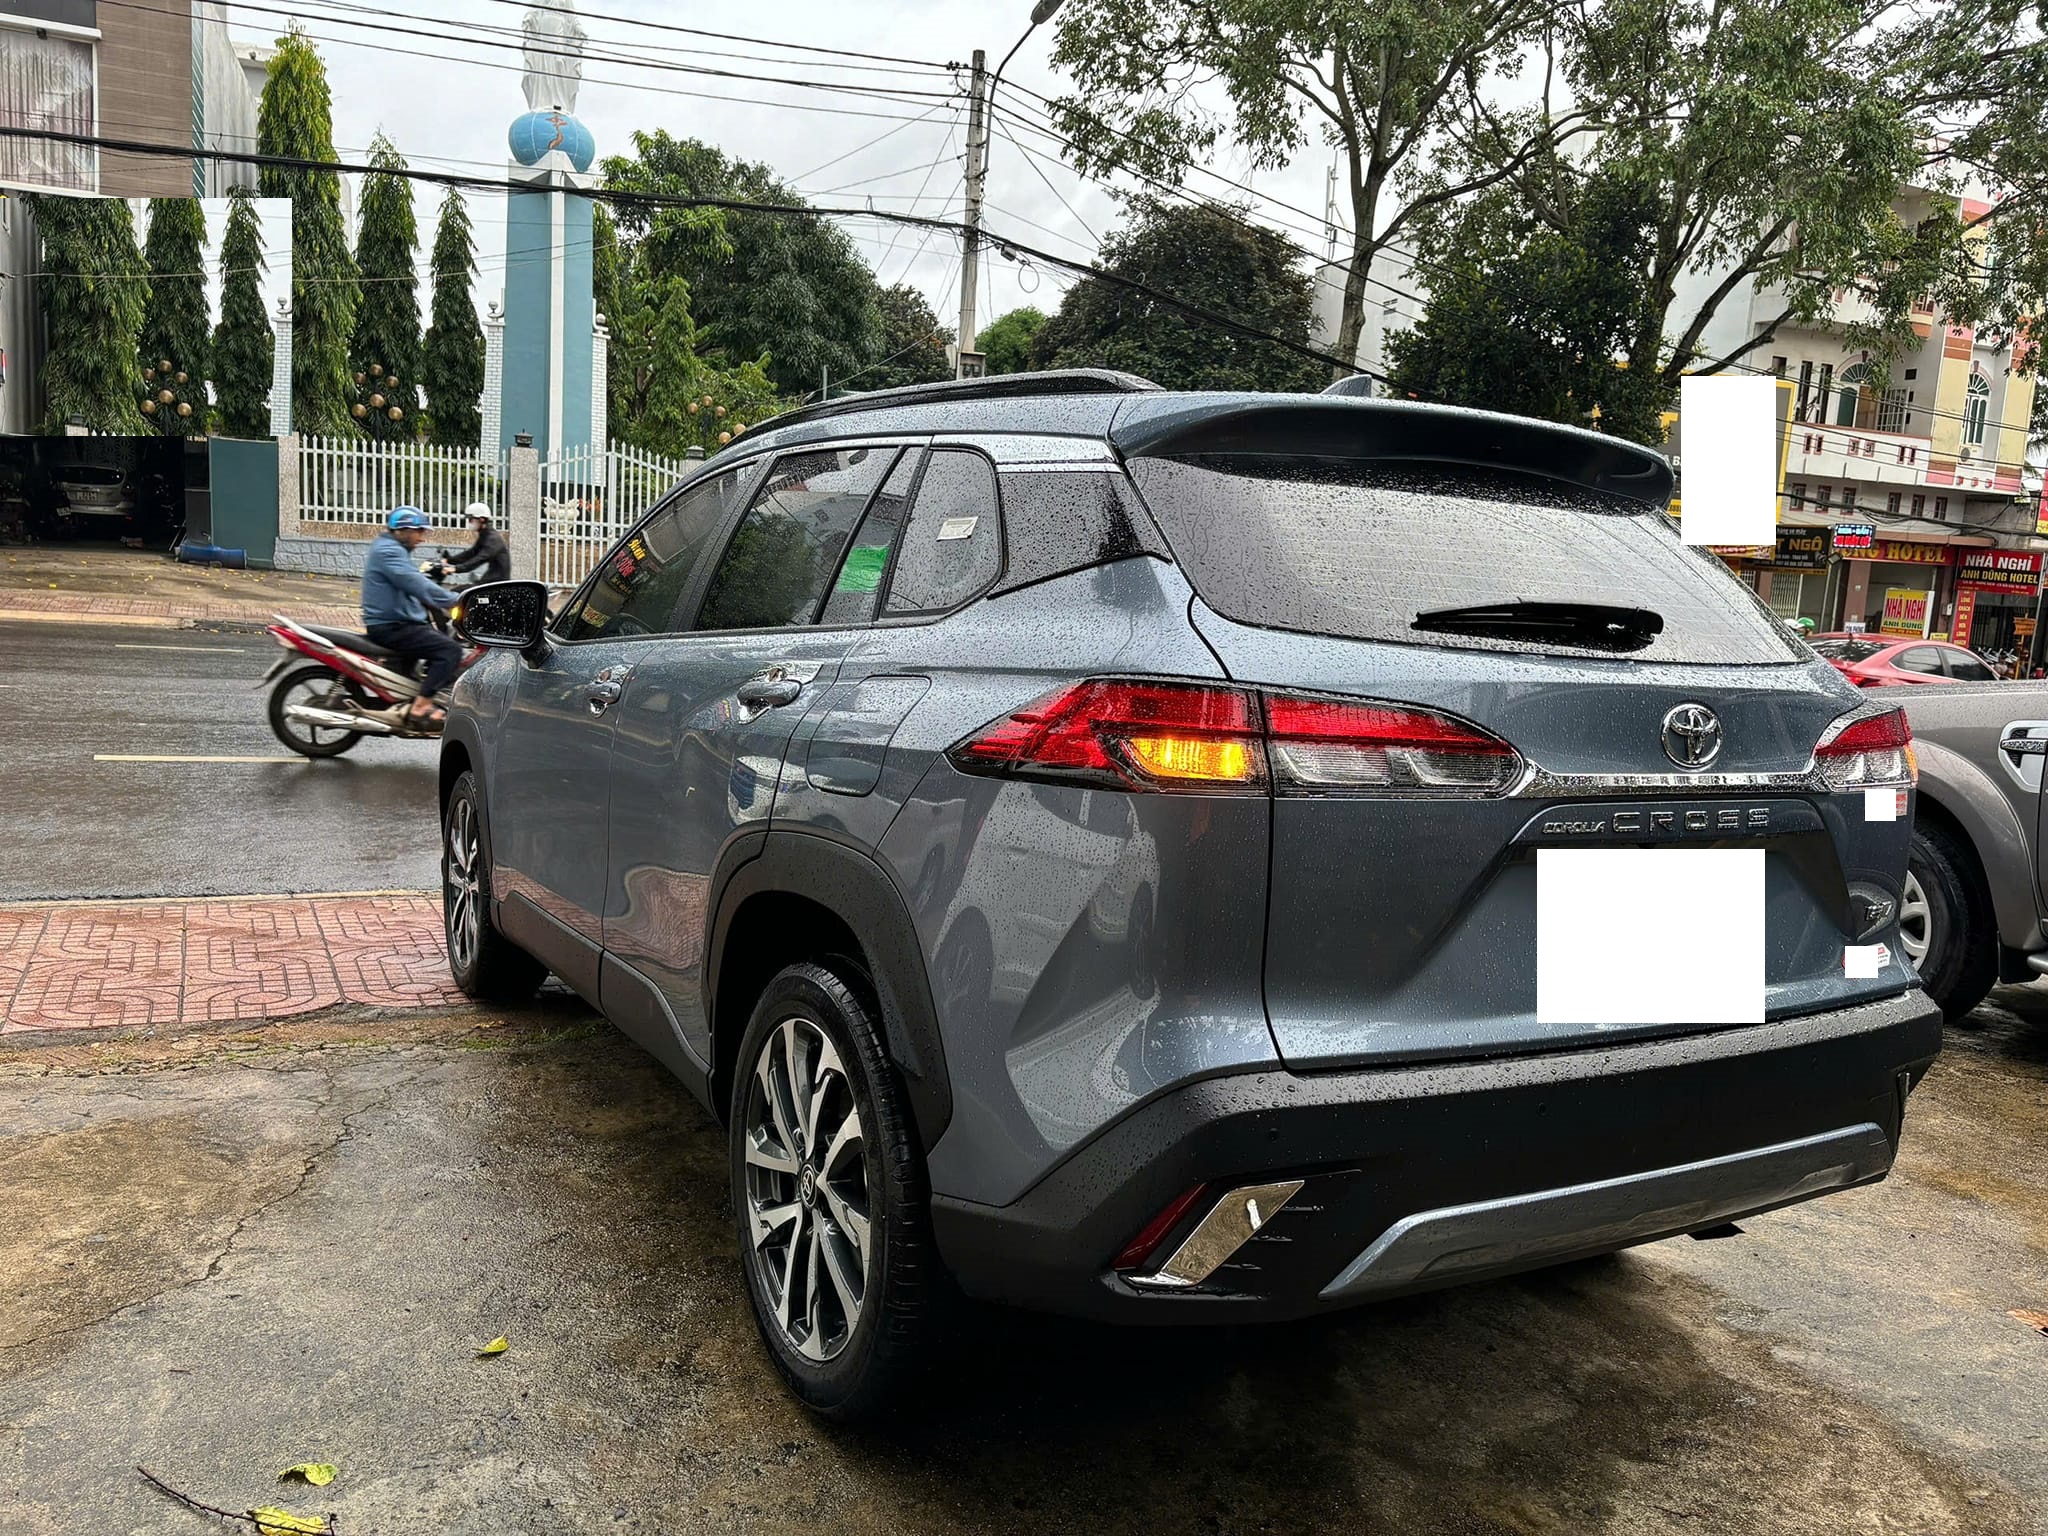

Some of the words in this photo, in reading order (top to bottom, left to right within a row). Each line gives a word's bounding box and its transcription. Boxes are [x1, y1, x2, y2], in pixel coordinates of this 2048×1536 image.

[1789, 536, 1822, 551] NGÔ
[1888, 543, 1945, 562] HOTEL
[1966, 553, 1993, 567] NHÀ
[1998, 555, 2033, 571] NGHỈ
[1960, 569, 1980, 579] ANH
[2009, 573, 2039, 584] HOTEL
[1613, 808, 1769, 832] CROSS
